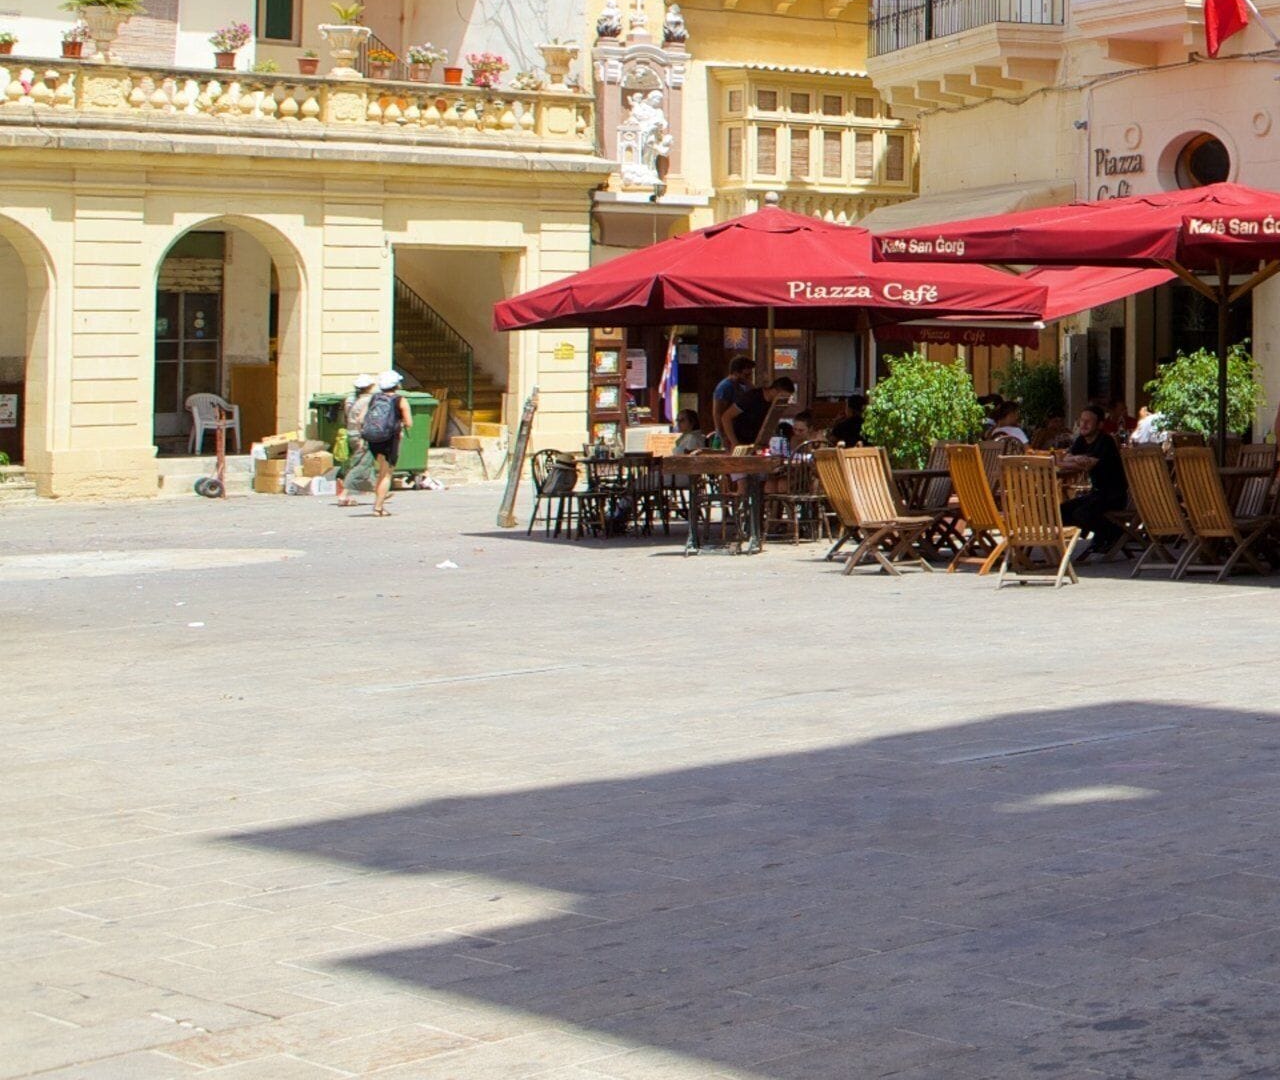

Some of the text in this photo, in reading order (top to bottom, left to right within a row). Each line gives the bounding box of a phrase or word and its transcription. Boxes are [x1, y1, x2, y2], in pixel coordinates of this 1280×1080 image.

[1094, 148, 1144, 177] Piazza
[1229, 218, 1259, 235] San
[908, 238, 932, 254] San
[787, 281, 938, 306] Piazza Café
